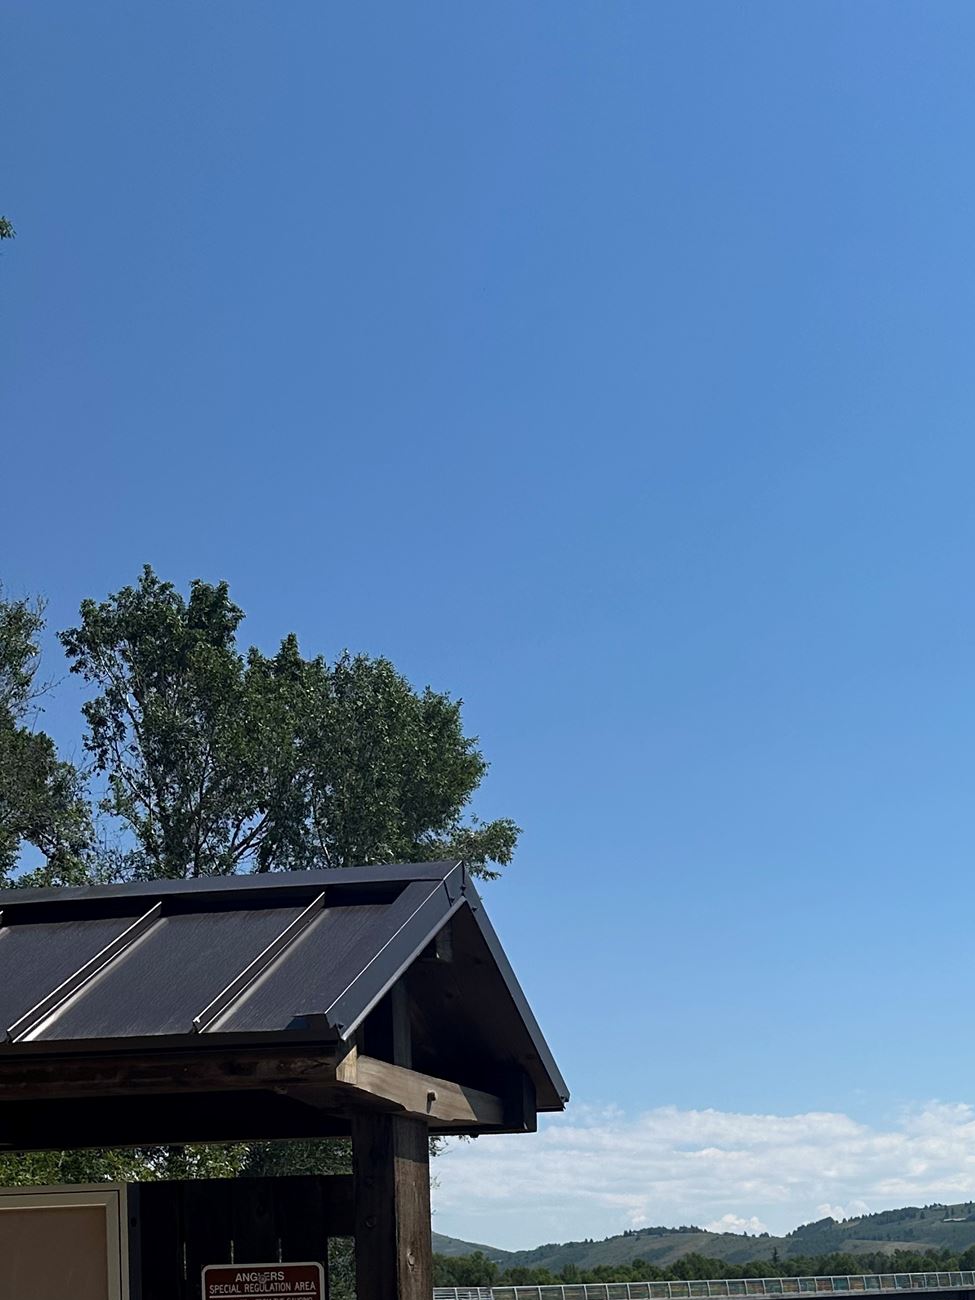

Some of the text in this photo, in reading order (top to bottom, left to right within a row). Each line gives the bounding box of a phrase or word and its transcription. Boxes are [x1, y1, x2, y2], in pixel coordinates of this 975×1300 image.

[209, 1281, 316, 1294] SPECIAL REGULATION AREA
